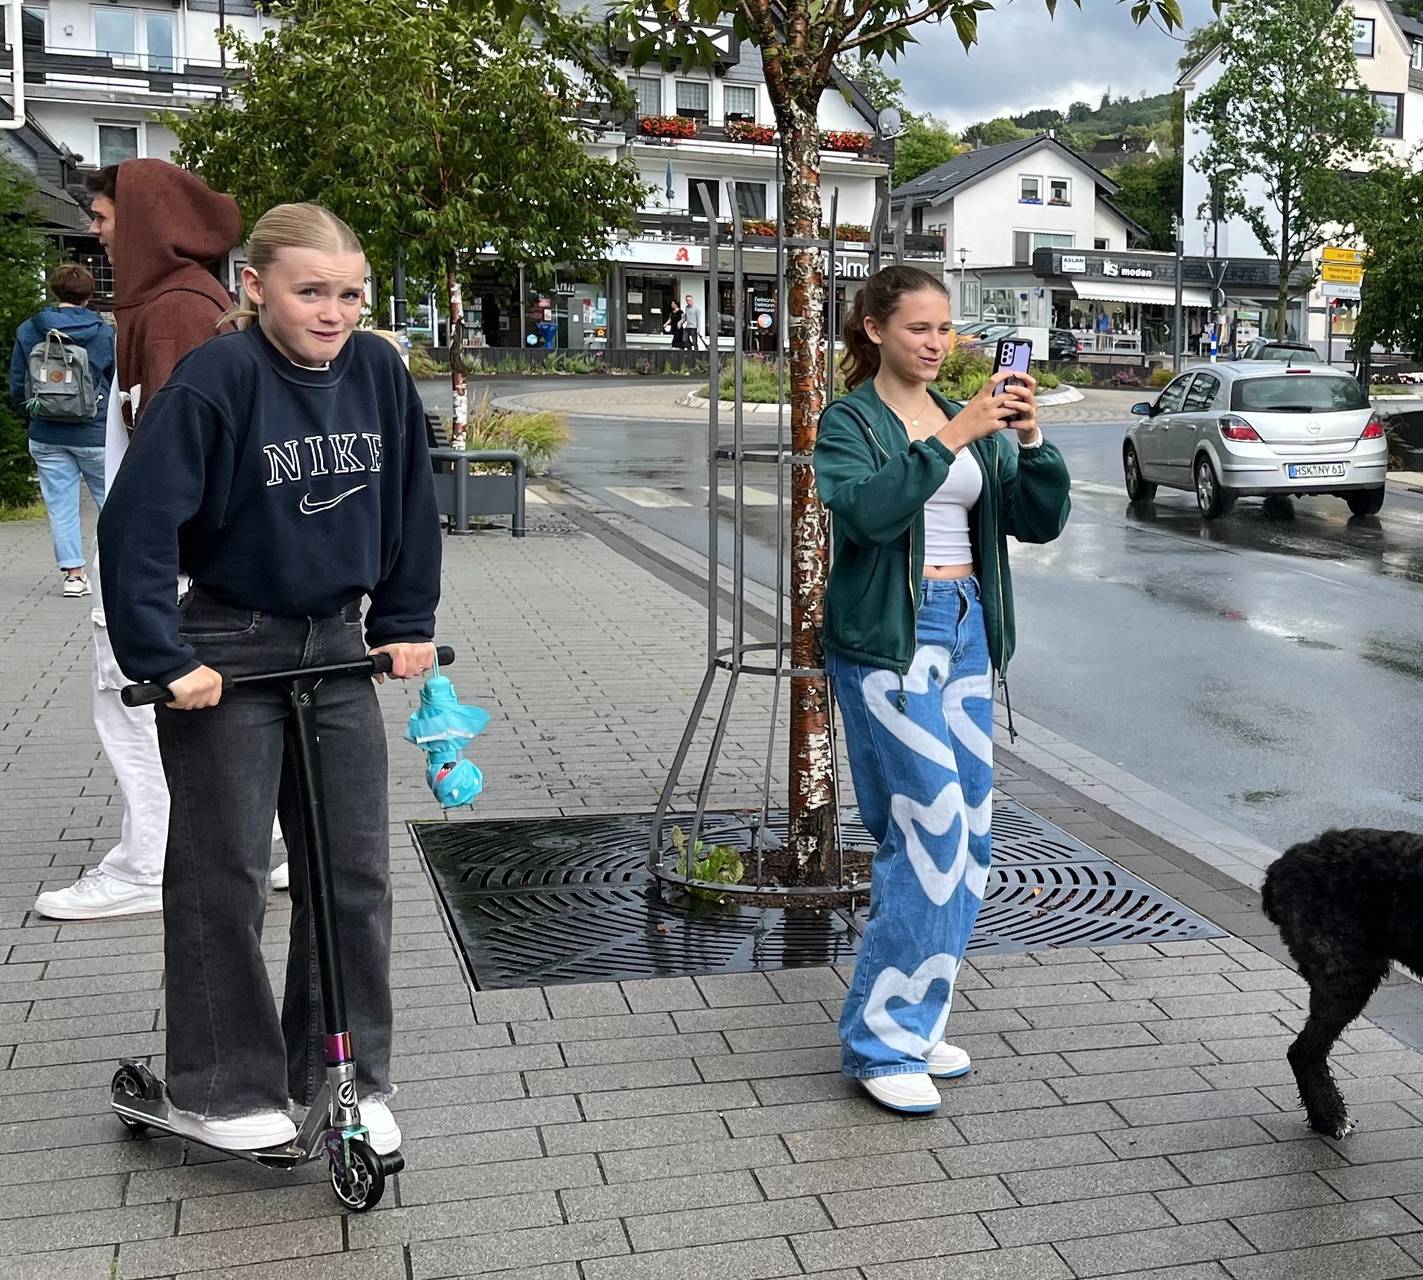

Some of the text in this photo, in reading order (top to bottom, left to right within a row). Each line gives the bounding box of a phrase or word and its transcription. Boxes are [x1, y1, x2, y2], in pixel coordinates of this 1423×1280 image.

[1121, 268, 1153, 278] moden
[263, 432, 382, 487] NIKE
[1295, 465, 1343, 476] HSK NY 61
